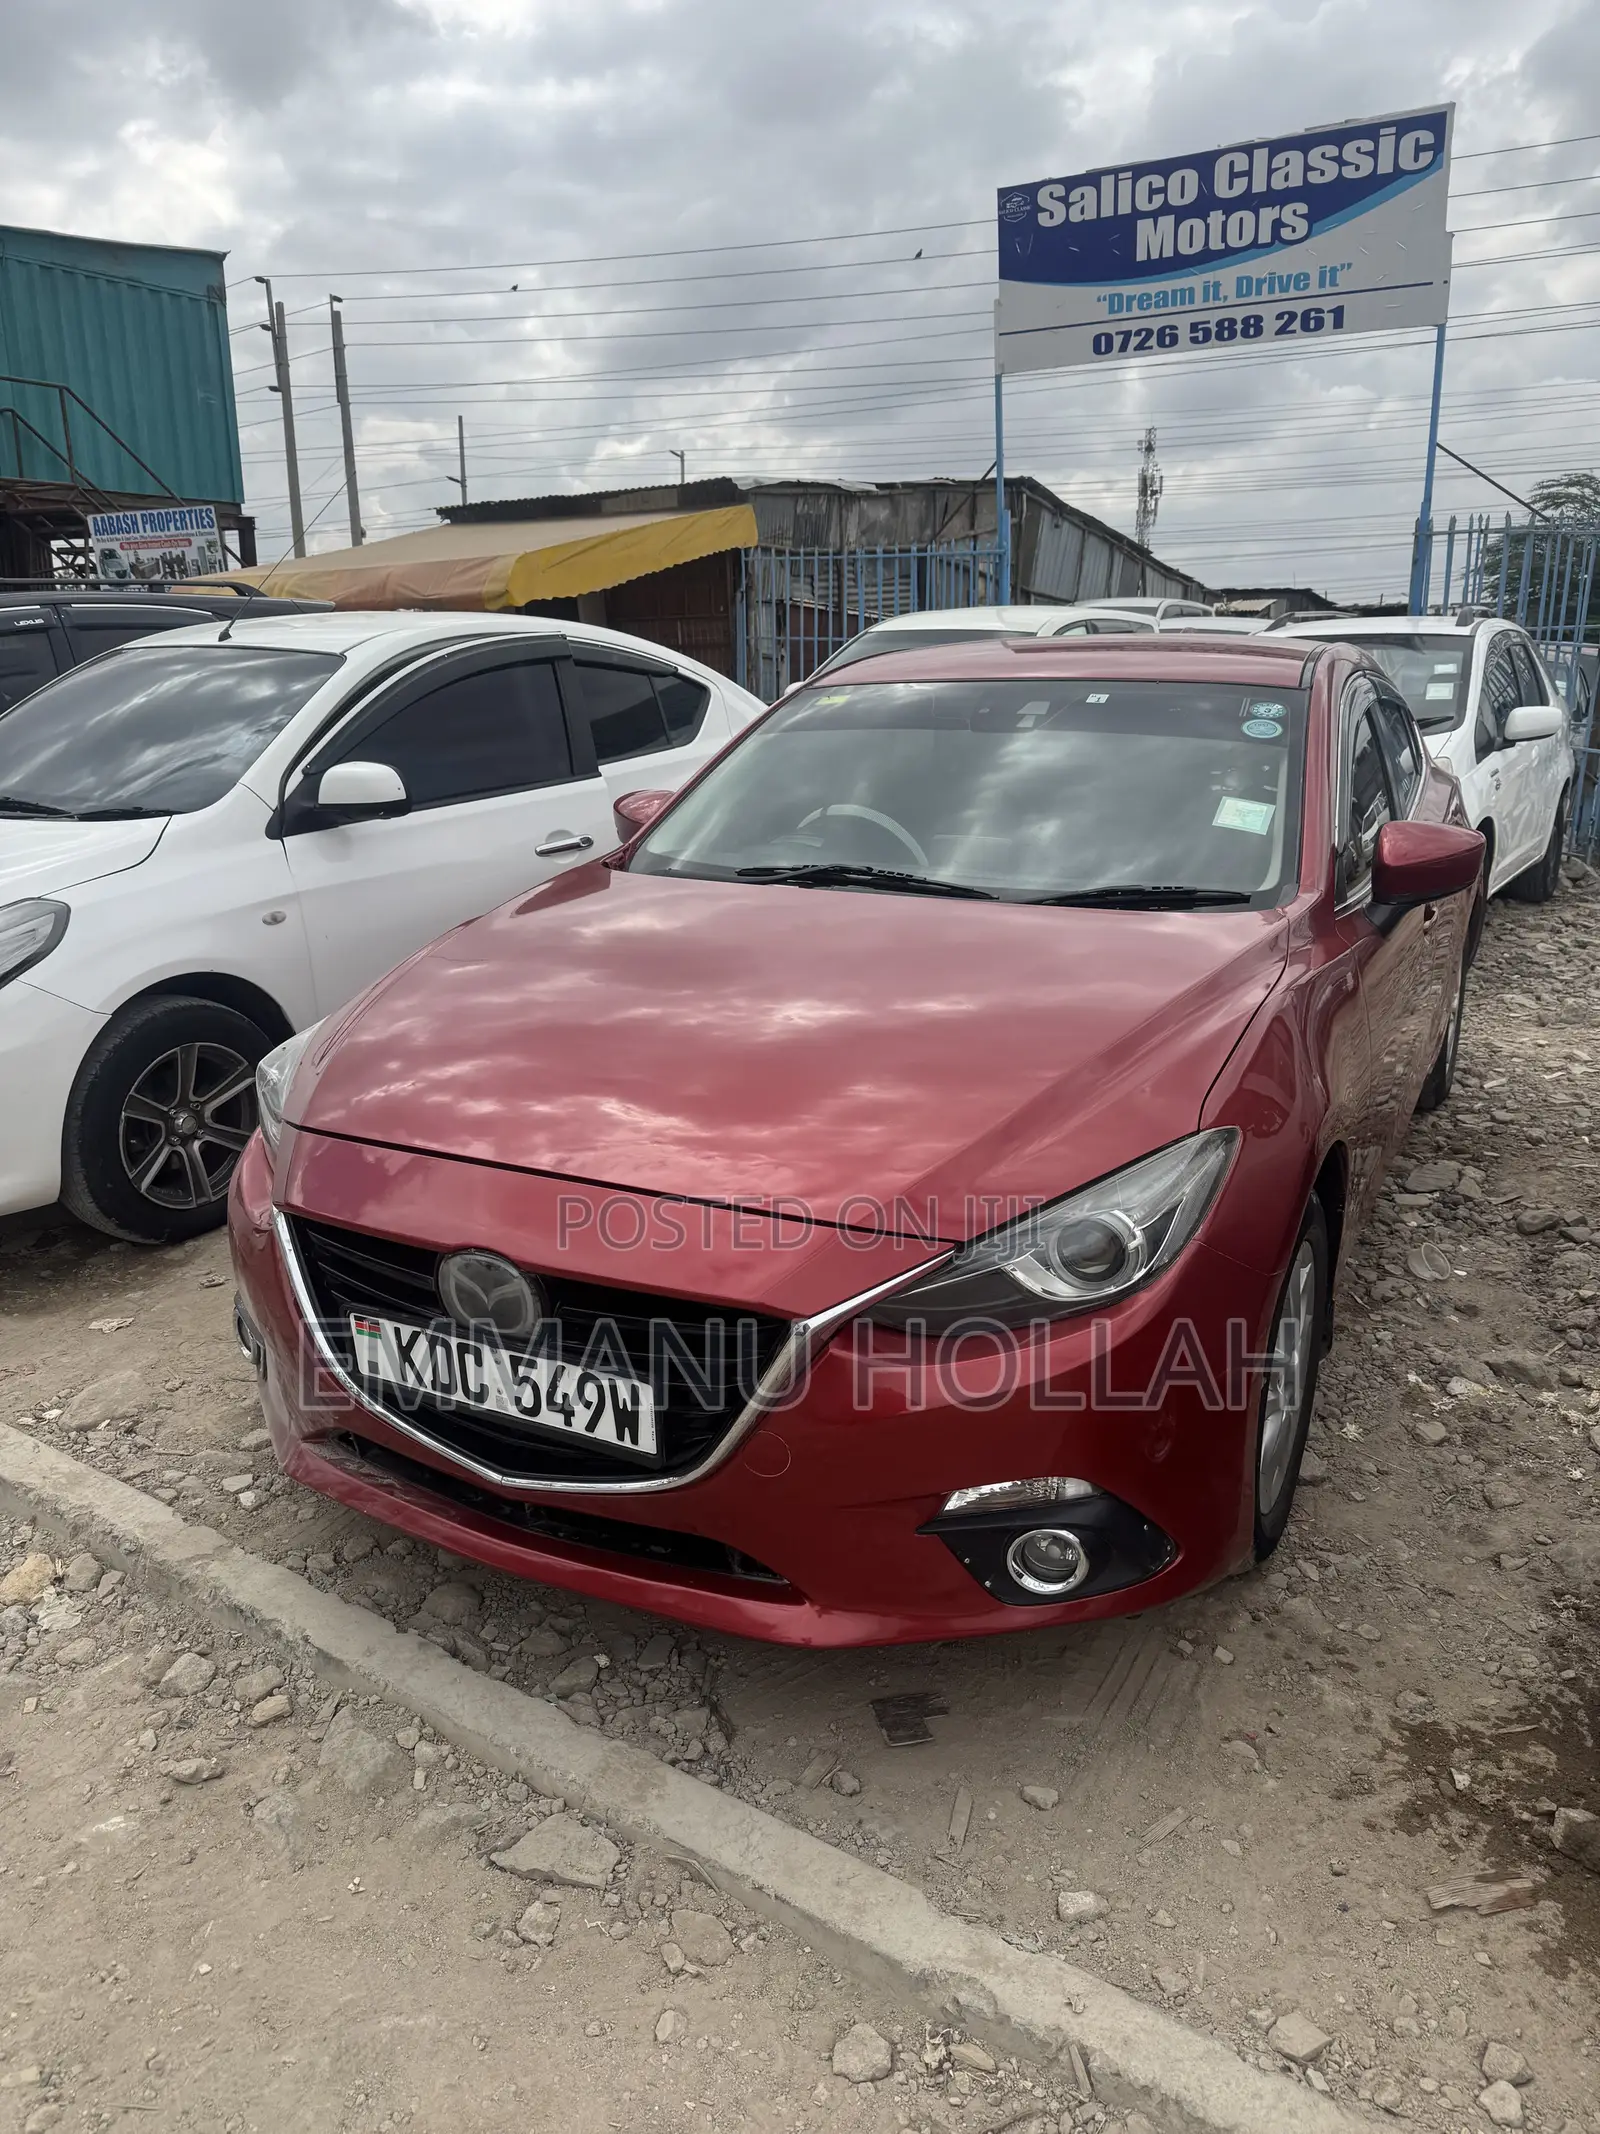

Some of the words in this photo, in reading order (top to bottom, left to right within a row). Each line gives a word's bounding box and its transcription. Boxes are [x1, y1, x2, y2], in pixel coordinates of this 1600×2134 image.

[1037, 168, 1199, 228] Salico
[1214, 127, 1436, 199] Classic
[1135, 202, 1310, 263] Motors
[1202, 276, 1229, 303] it,
[1236, 267, 1311, 297] Drive
[1092, 324, 1180, 356] 0726
[1188, 315, 1264, 346] 588
[1275, 304, 1346, 336] 261
[141, 507, 215, 534] PROPERTIES
[14, 618, 44, 626] LEXUS
[393, 1326, 490, 1405] KDC
[509, 1355, 642, 1446] 549W
